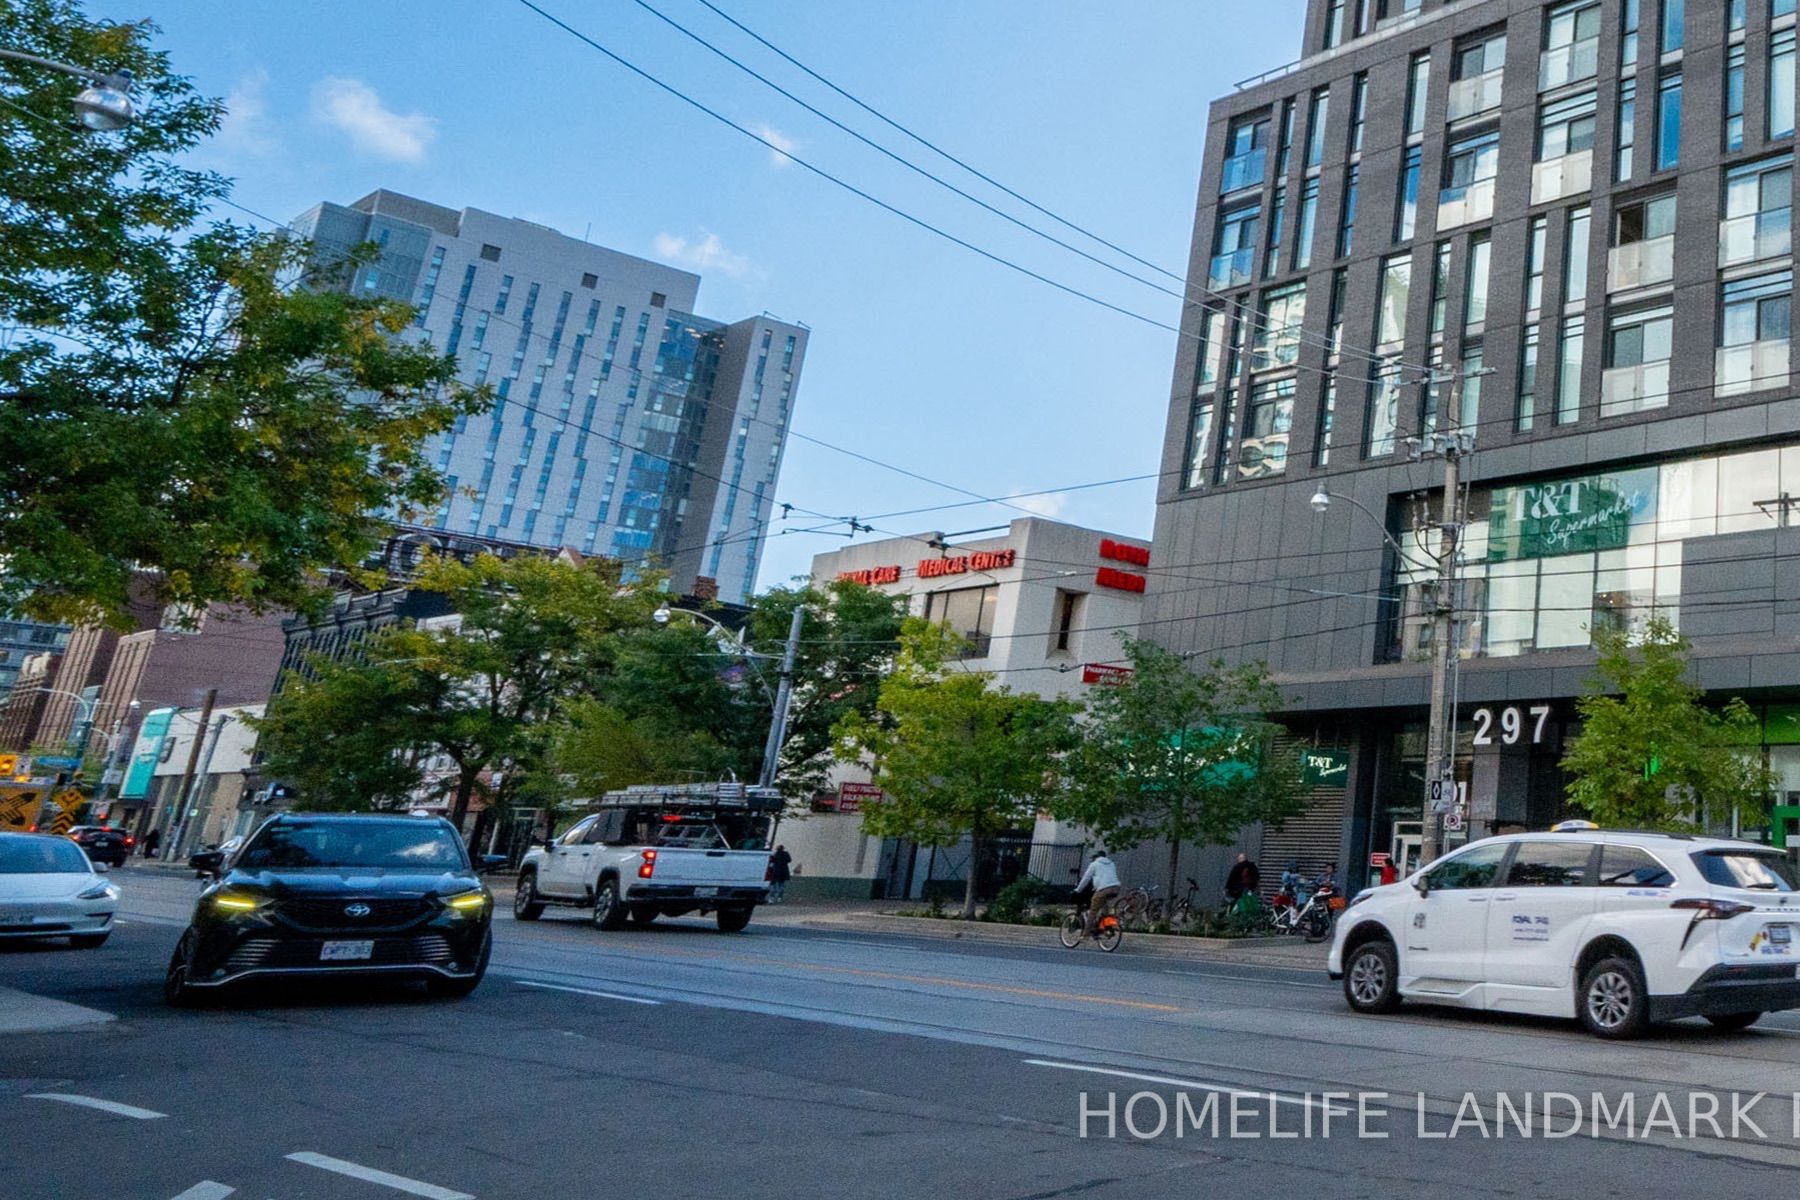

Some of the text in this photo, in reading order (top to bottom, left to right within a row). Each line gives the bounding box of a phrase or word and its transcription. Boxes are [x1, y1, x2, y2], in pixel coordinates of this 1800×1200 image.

[1508, 481, 1589, 522] T&T
[1547, 490, 1639, 548] Supermarket
[917, 557, 968, 579] MEDICAL
[1473, 705, 1549, 745] 297
[1308, 756, 1333, 769] T&T
